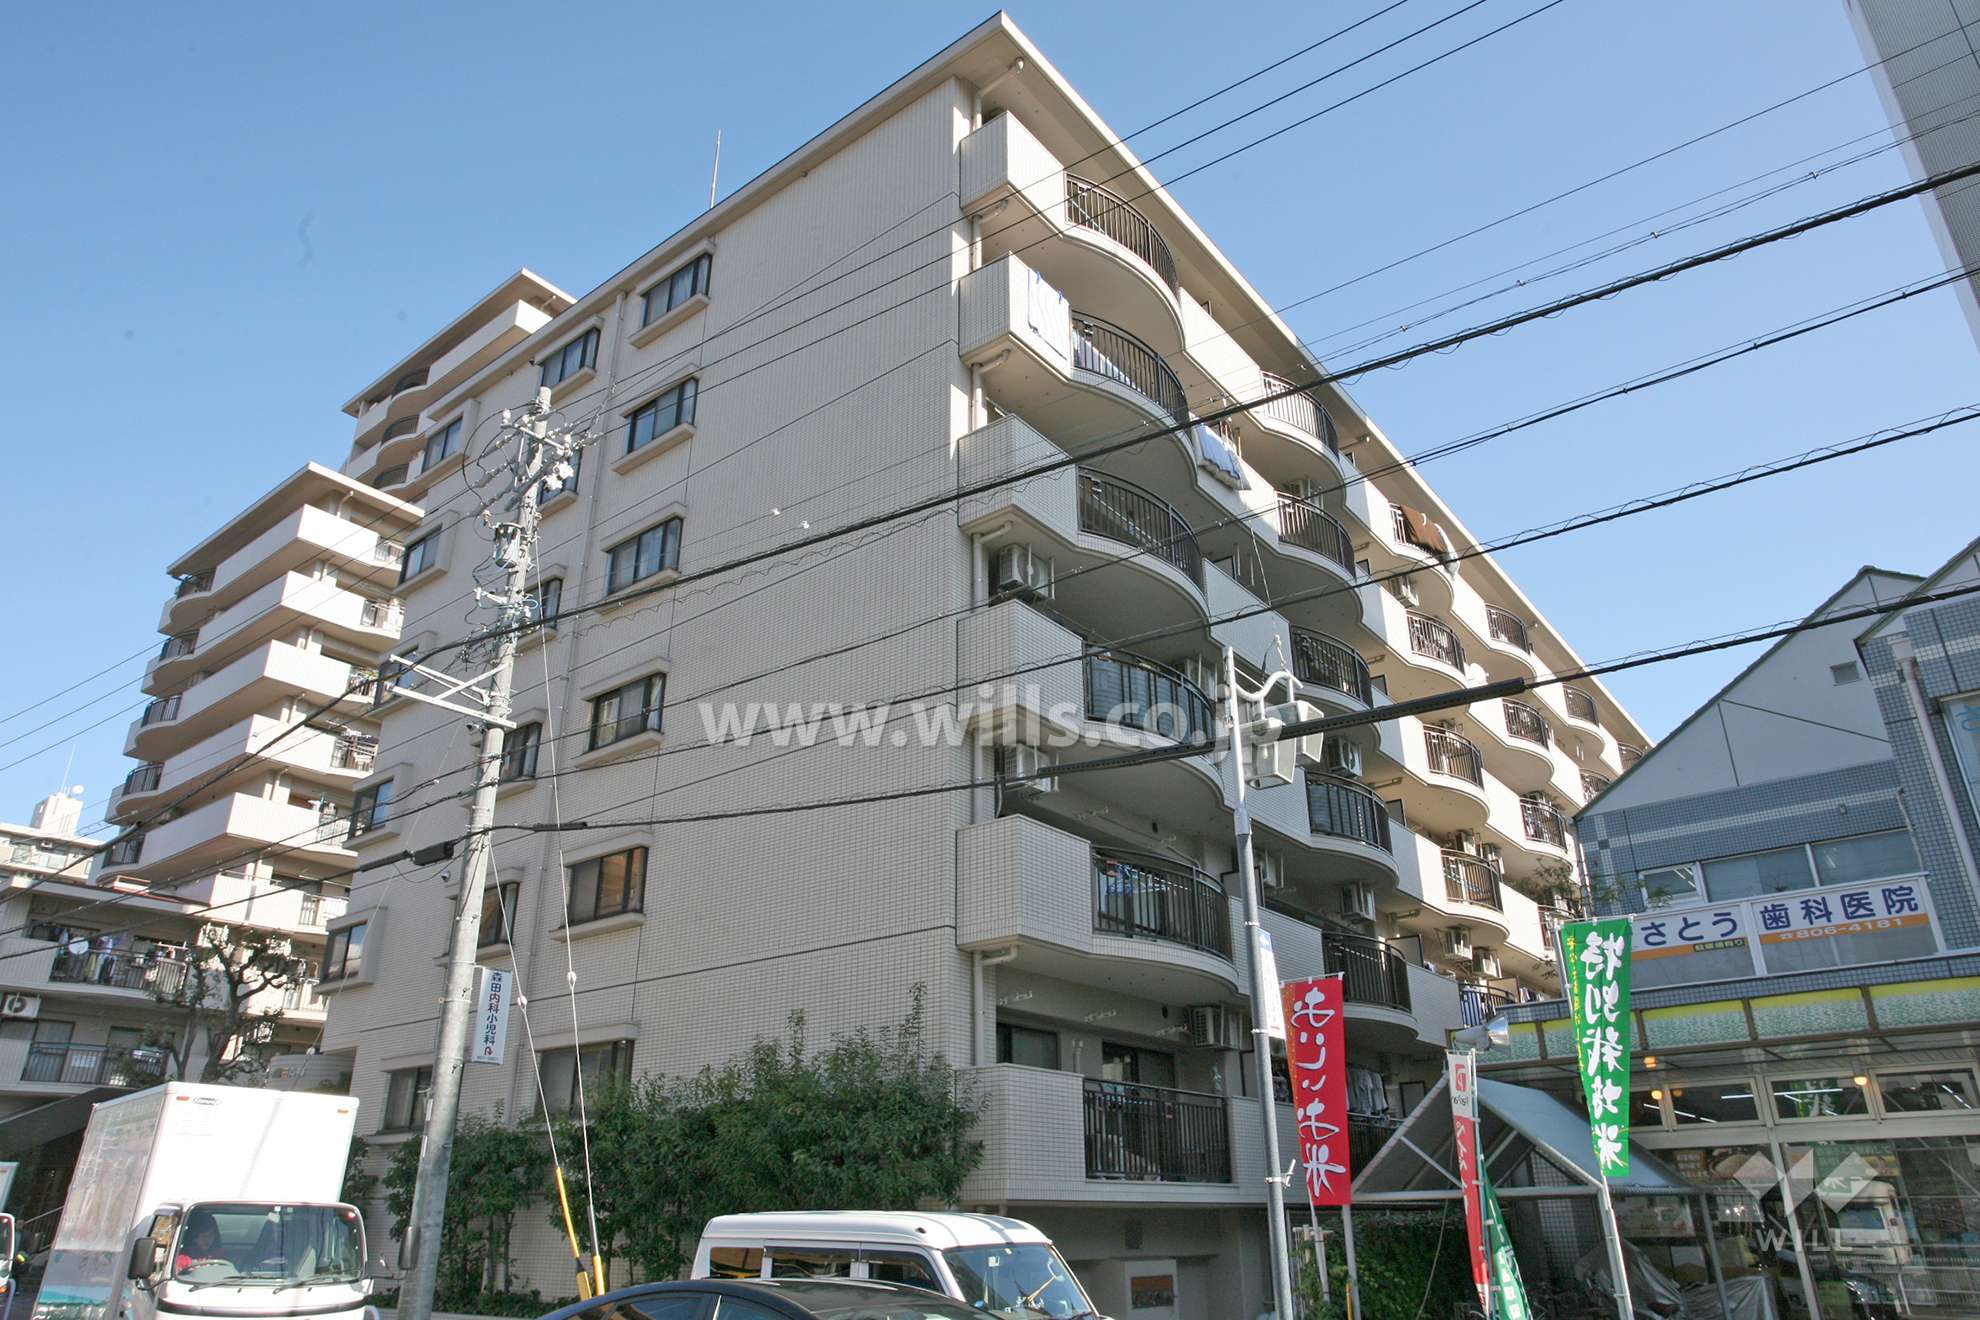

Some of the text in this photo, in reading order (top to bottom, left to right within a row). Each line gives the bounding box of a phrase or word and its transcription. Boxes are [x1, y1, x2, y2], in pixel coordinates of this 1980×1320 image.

[1641, 885, 1919, 946] さとう 歯科医院
[483, 972, 502, 1046] 森田内科小児科
